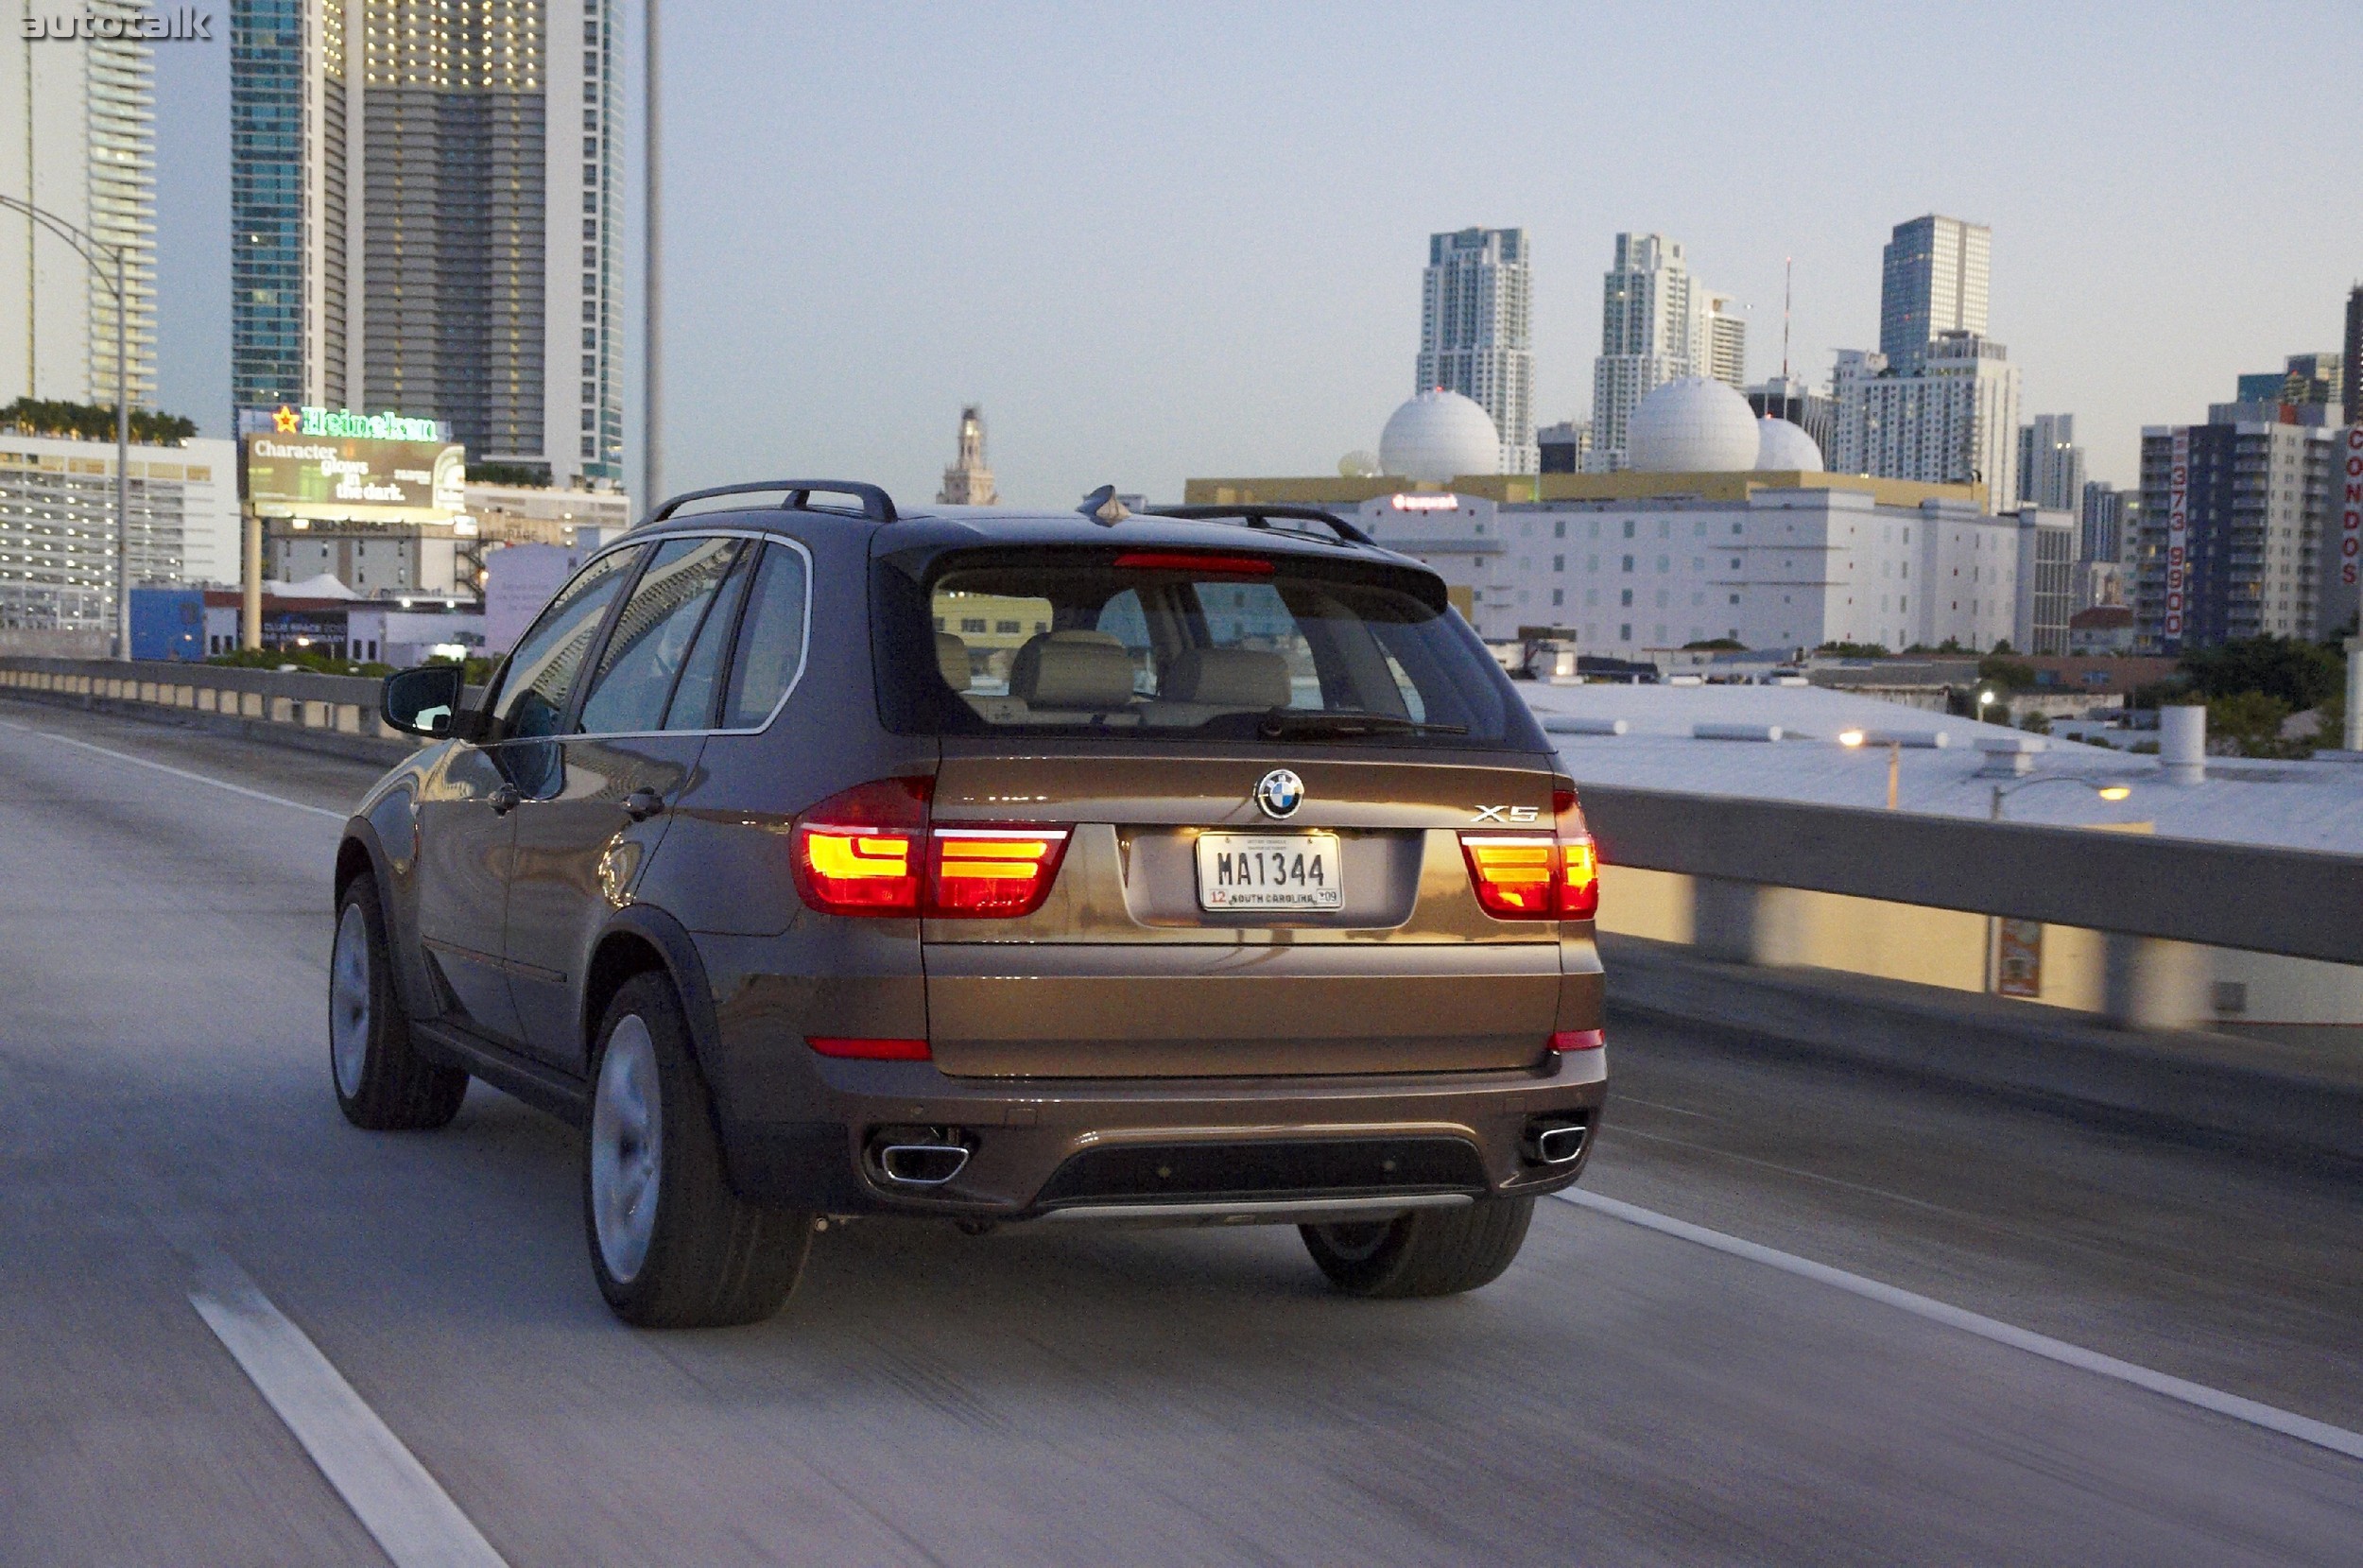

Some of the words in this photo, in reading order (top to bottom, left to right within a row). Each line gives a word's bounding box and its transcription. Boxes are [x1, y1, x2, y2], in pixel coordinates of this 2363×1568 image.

[301, 406, 438, 441] Heineken
[254, 439, 337, 459] Character
[320, 459, 370, 476] glows
[336, 482, 363, 499] the
[363, 482, 405, 501] dark.
[2172, 465, 2186, 532] 373
[2343, 429, 2363, 584] CONDOS
[2166, 546, 2183, 633] 9900
[1470, 805, 1539, 822] X5
[1217, 853, 1323, 886] MA1344
[1211, 891, 1227, 904] 12
[1232, 893, 1264, 903] SOUTH
[1266, 893, 1314, 903] CAROLINA
